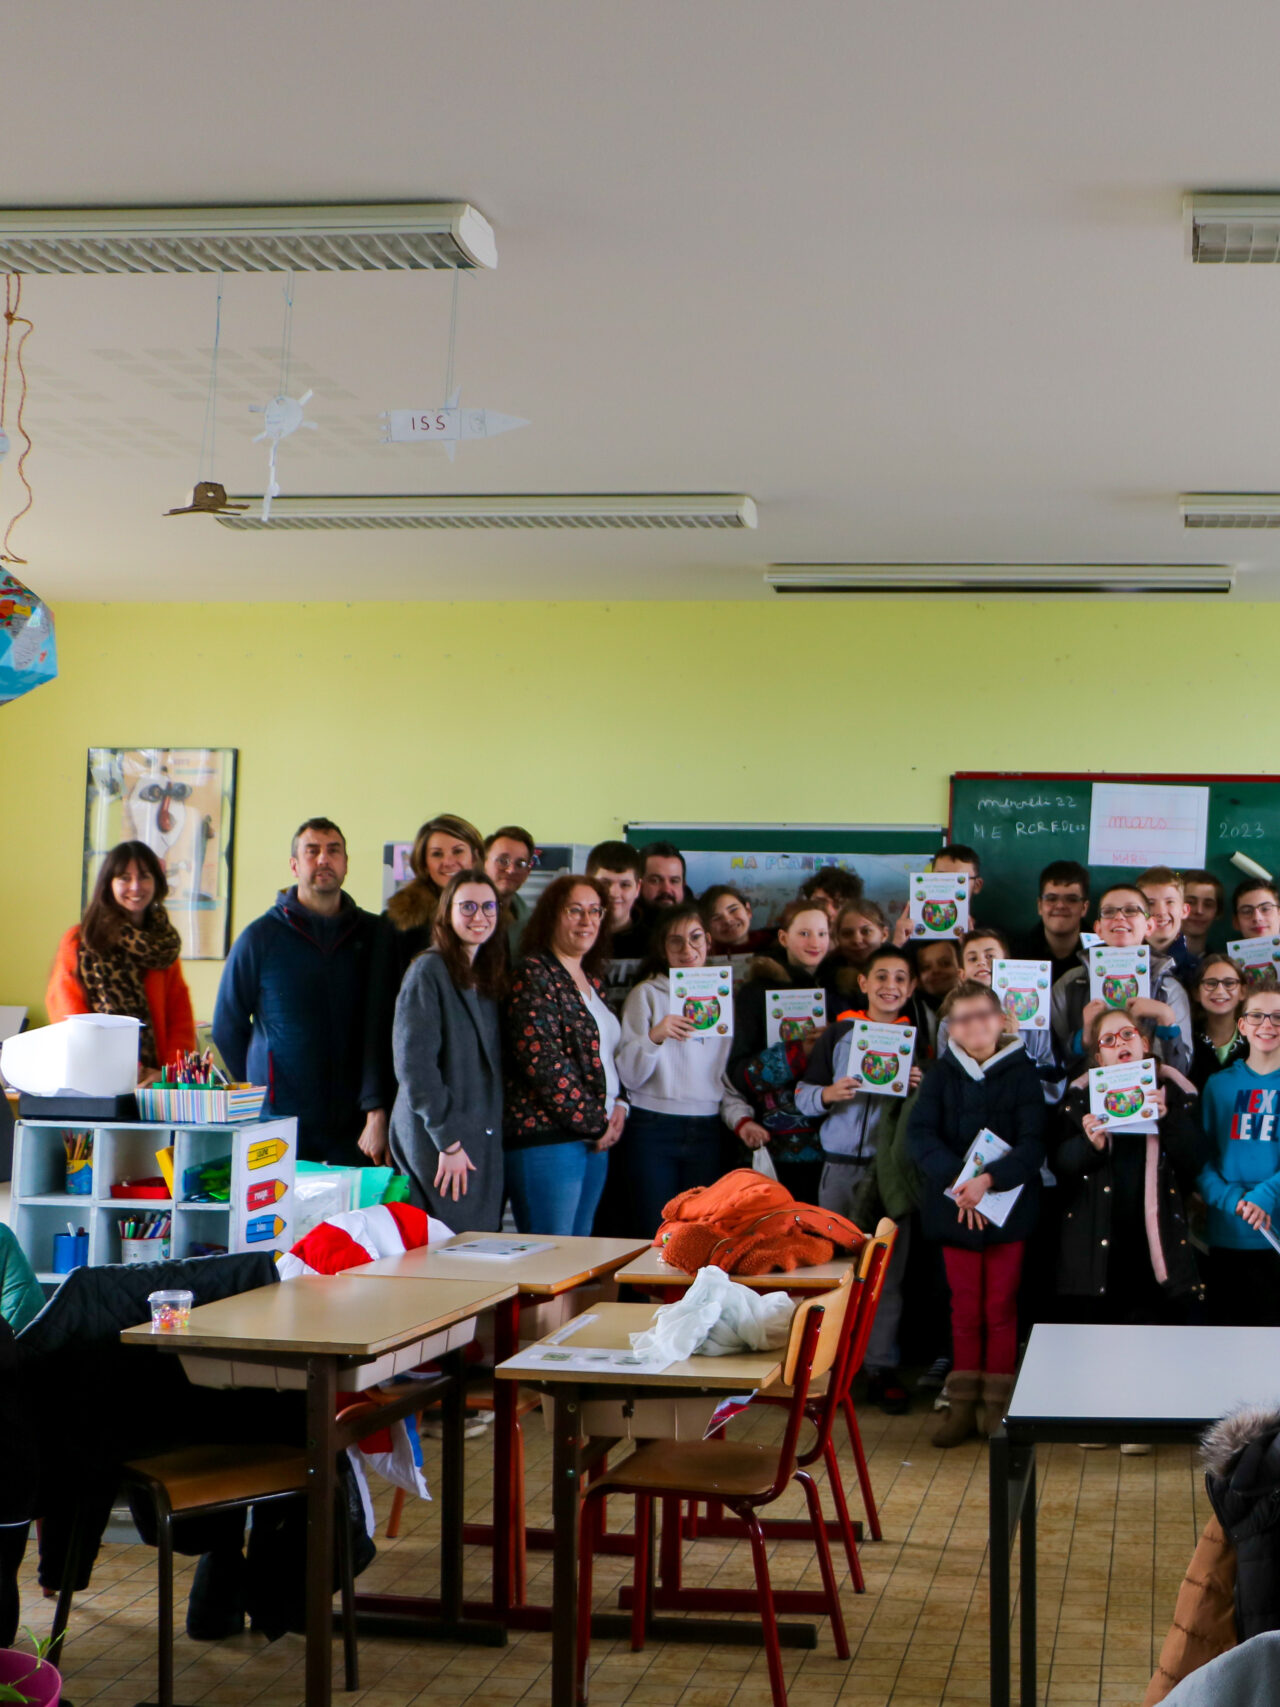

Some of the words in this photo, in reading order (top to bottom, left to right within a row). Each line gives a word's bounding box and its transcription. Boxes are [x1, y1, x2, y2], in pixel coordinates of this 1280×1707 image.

[411, 415, 446, 431] ISS
[1055, 796, 1077, 808] 22
[1108, 815, 1168, 831] mars
[1219, 822, 1265, 839] 2023
[1230, 1113, 1280, 1142] LEVEL
